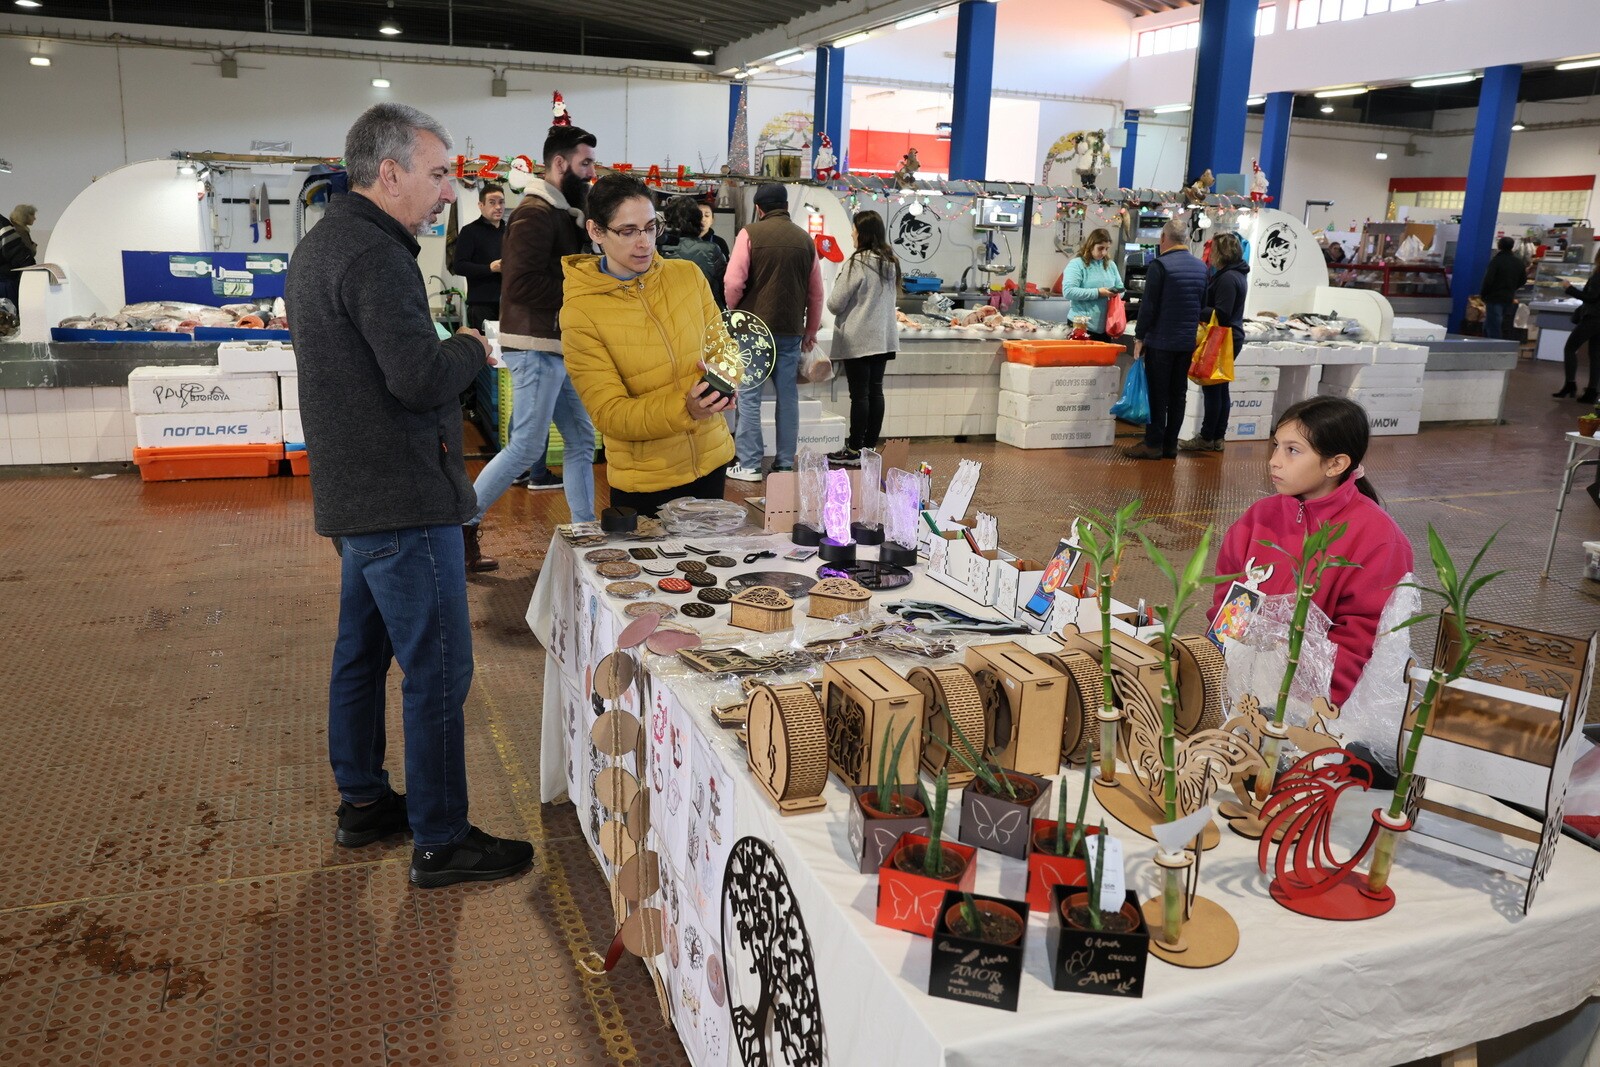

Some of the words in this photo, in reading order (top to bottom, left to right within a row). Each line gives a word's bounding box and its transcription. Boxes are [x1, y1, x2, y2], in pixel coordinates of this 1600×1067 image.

[163, 424, 248, 437] NORDLAKS
[1051, 432, 1075, 440] SEAFOOD
[797, 435, 840, 444] Hiddenfjord
[950, 964, 1002, 982] AMOR
[1078, 969, 1121, 986] Aqui
